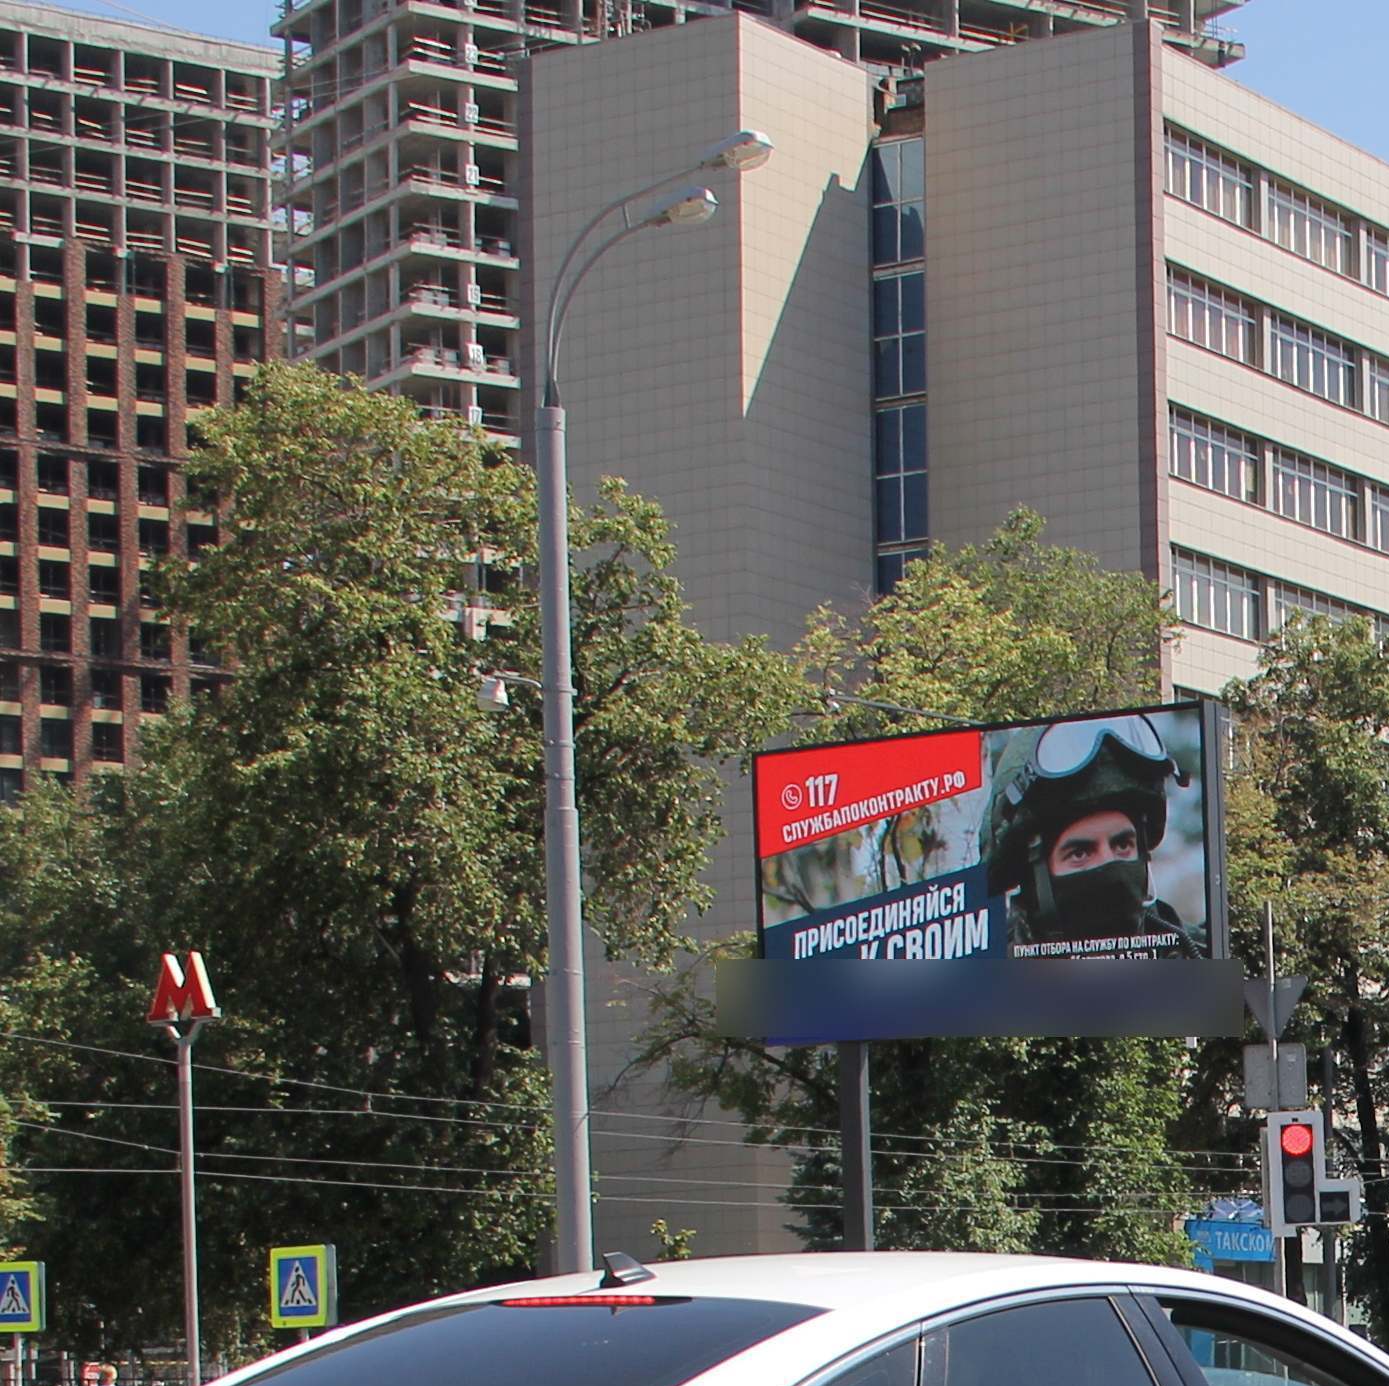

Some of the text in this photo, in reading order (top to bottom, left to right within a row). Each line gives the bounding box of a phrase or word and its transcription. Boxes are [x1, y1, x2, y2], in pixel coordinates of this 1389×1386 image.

[782, 770, 966, 844] СЛУЖБАПОКОНТРАКТУ.РФ
[805, 773, 839, 808] 117
[794, 882, 965, 960] ПРИСОЕДИНЯЙСЯ
[1013, 943, 1040, 958] ПУНКТ
[1041, 942, 1071, 956] ОТБОРА
[1072, 940, 1083, 953] НА
[1084, 938, 1117, 953] СЛУЖБУ
[1118, 936, 1130, 950] ПО
[1130, 932, 1180, 949] КОНТРАКТУ:
[1215, 1231, 1275, 1252] ТАКСКОМ
